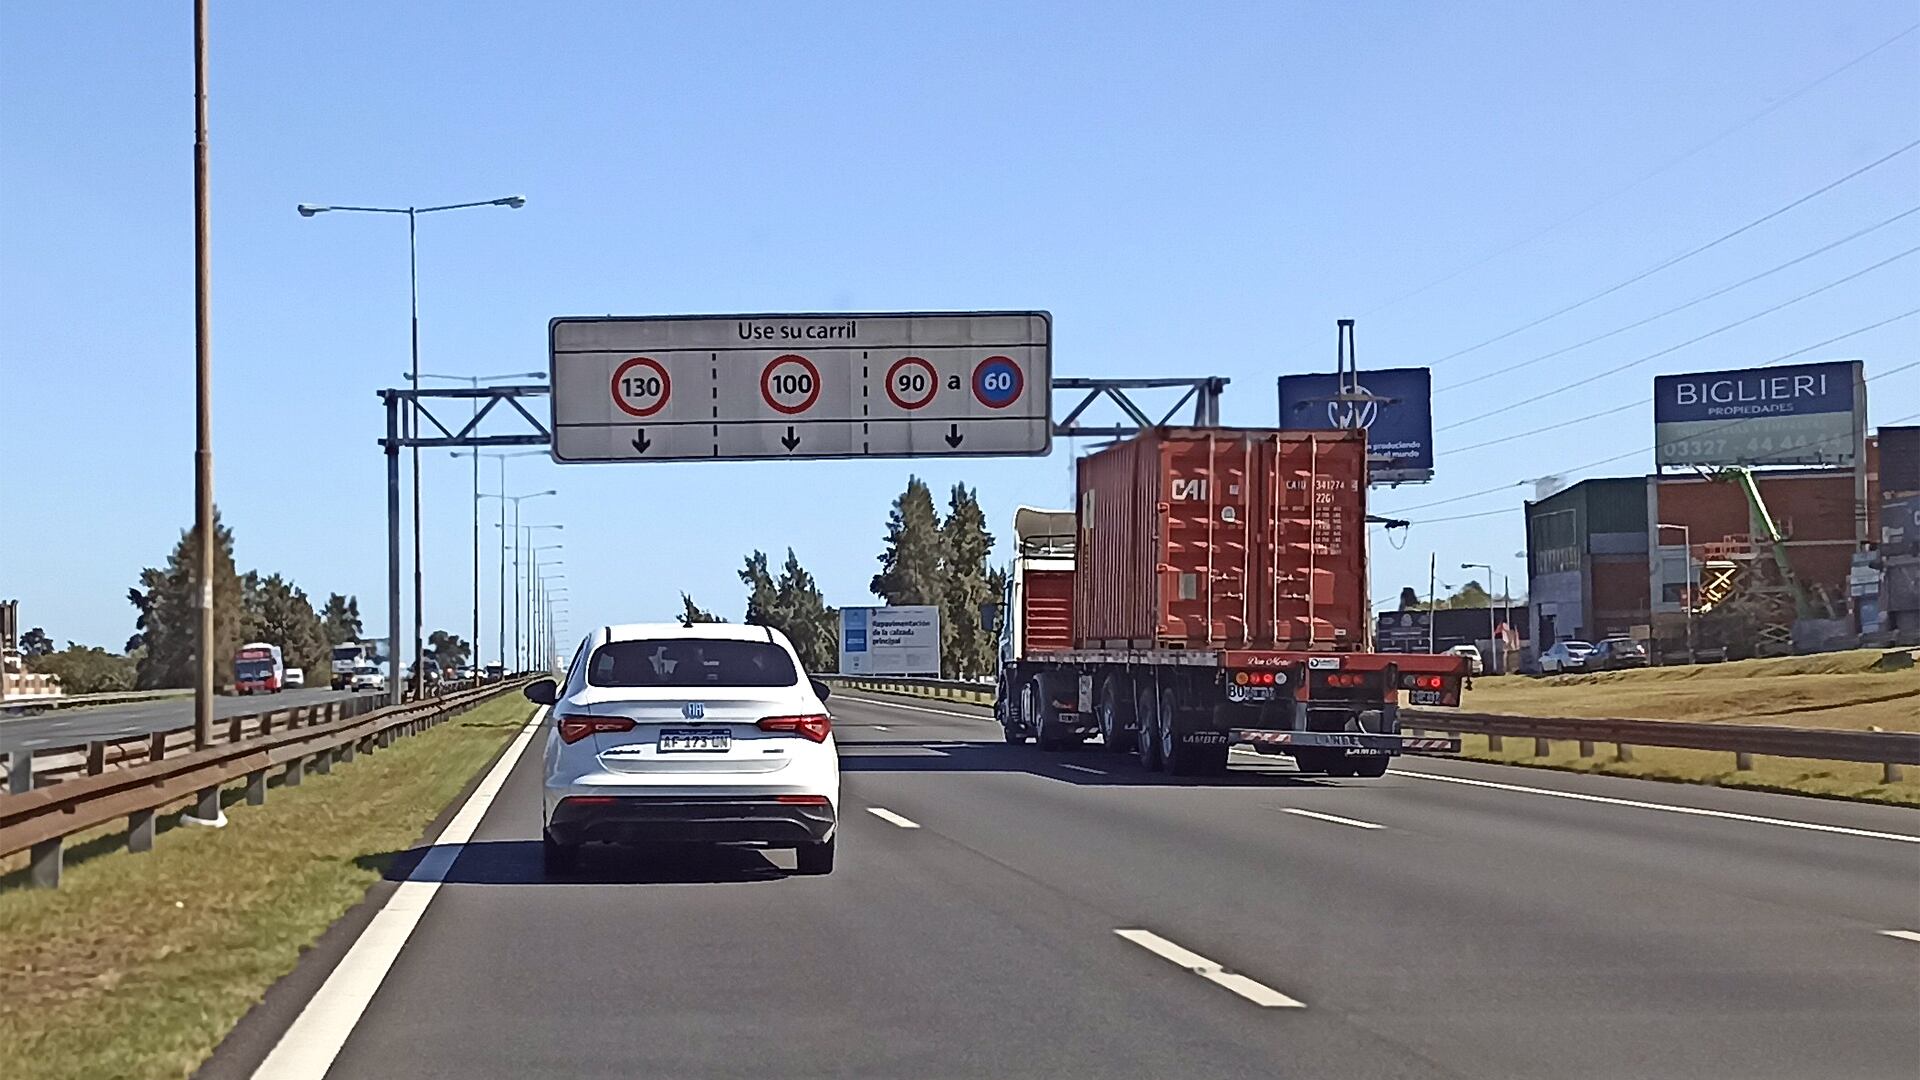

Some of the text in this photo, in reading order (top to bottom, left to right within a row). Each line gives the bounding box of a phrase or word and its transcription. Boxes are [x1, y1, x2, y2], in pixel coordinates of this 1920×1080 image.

[738, 321, 857, 340] Use su carril
[622, 378, 661, 396] 130
[772, 374, 812, 395] 100
[898, 373, 1011, 393] 90 a 60
[1676, 374, 1827, 406] BIGLIERI
[1708, 403, 1794, 415] PROPIEDADES
[1373, 441, 1421, 451] produciendo
[1392, 450, 1420, 458] mundo
[1663, 439, 1726, 457] 03327
[1746, 437, 1773, 452] 44
[1780, 434, 1807, 449] 44
[1171, 479, 1206, 500] CAI
[1286, 480, 1306, 490] CAIU
[1316, 480, 1345, 490] 341274
[872, 637, 901, 645] principal
[664, 736, 678, 748] AF
[684, 736, 707, 748] 173
